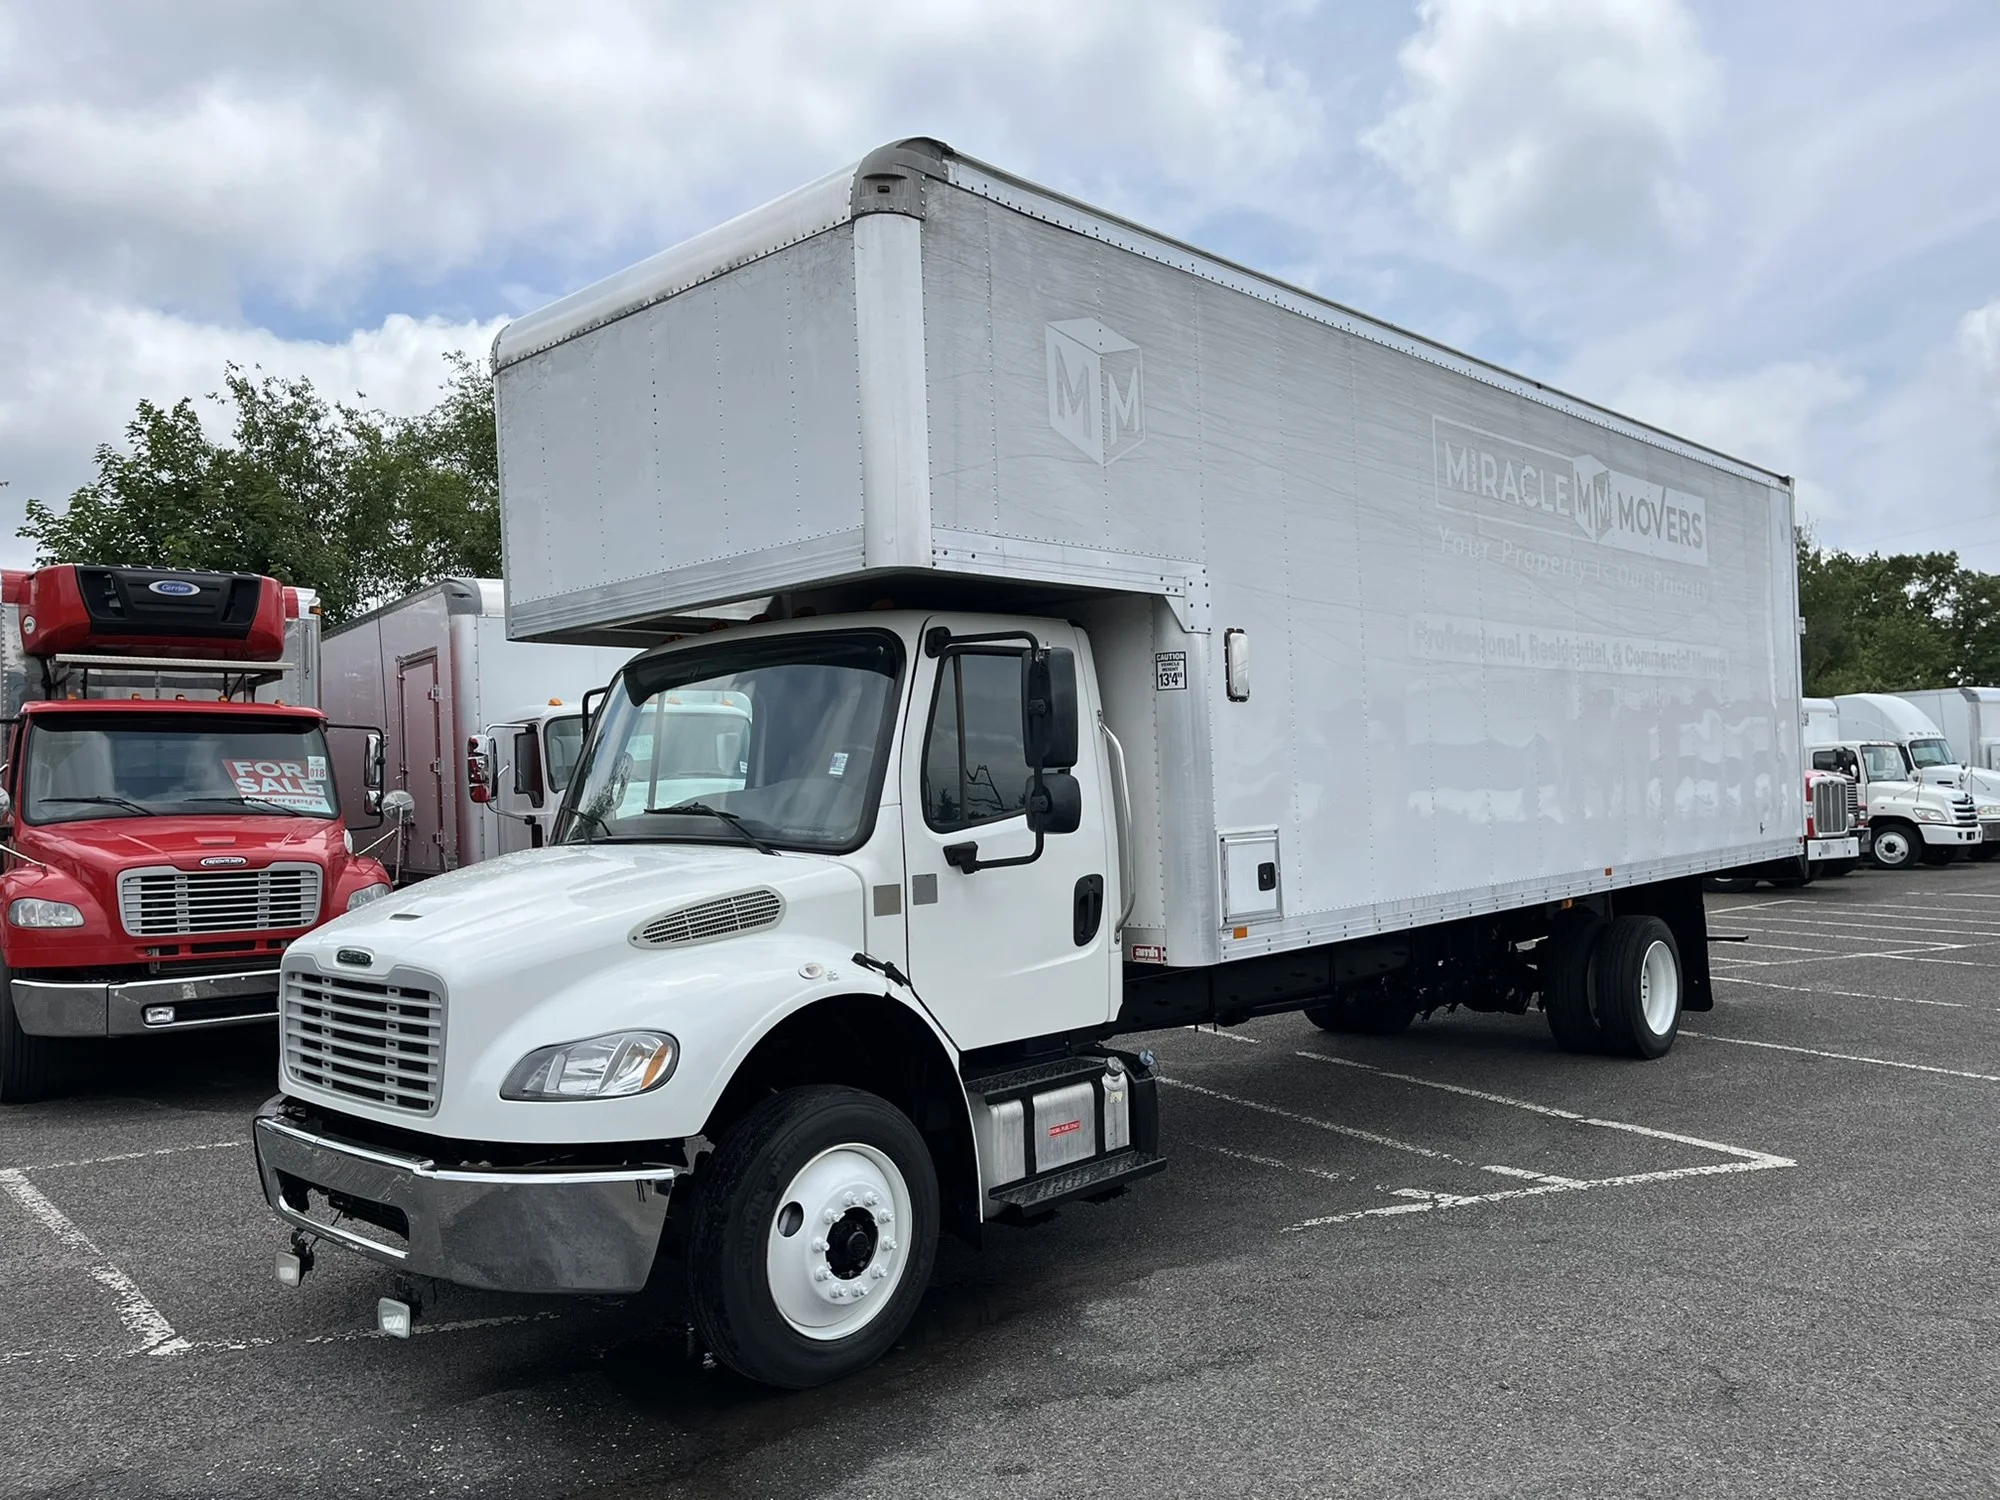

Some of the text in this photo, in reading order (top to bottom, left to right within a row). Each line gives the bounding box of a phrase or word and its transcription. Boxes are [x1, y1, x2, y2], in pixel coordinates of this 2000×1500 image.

[1444, 440, 1571, 516] MIRACLE
[1617, 486, 1703, 549] MOVERS
[1438, 524, 1490, 559] Your
[1502, 538, 1587, 585] Property
[1157, 653, 1185, 661] CAUTION
[232, 761, 305, 778] FOR
[236, 777, 326, 796] SALE
